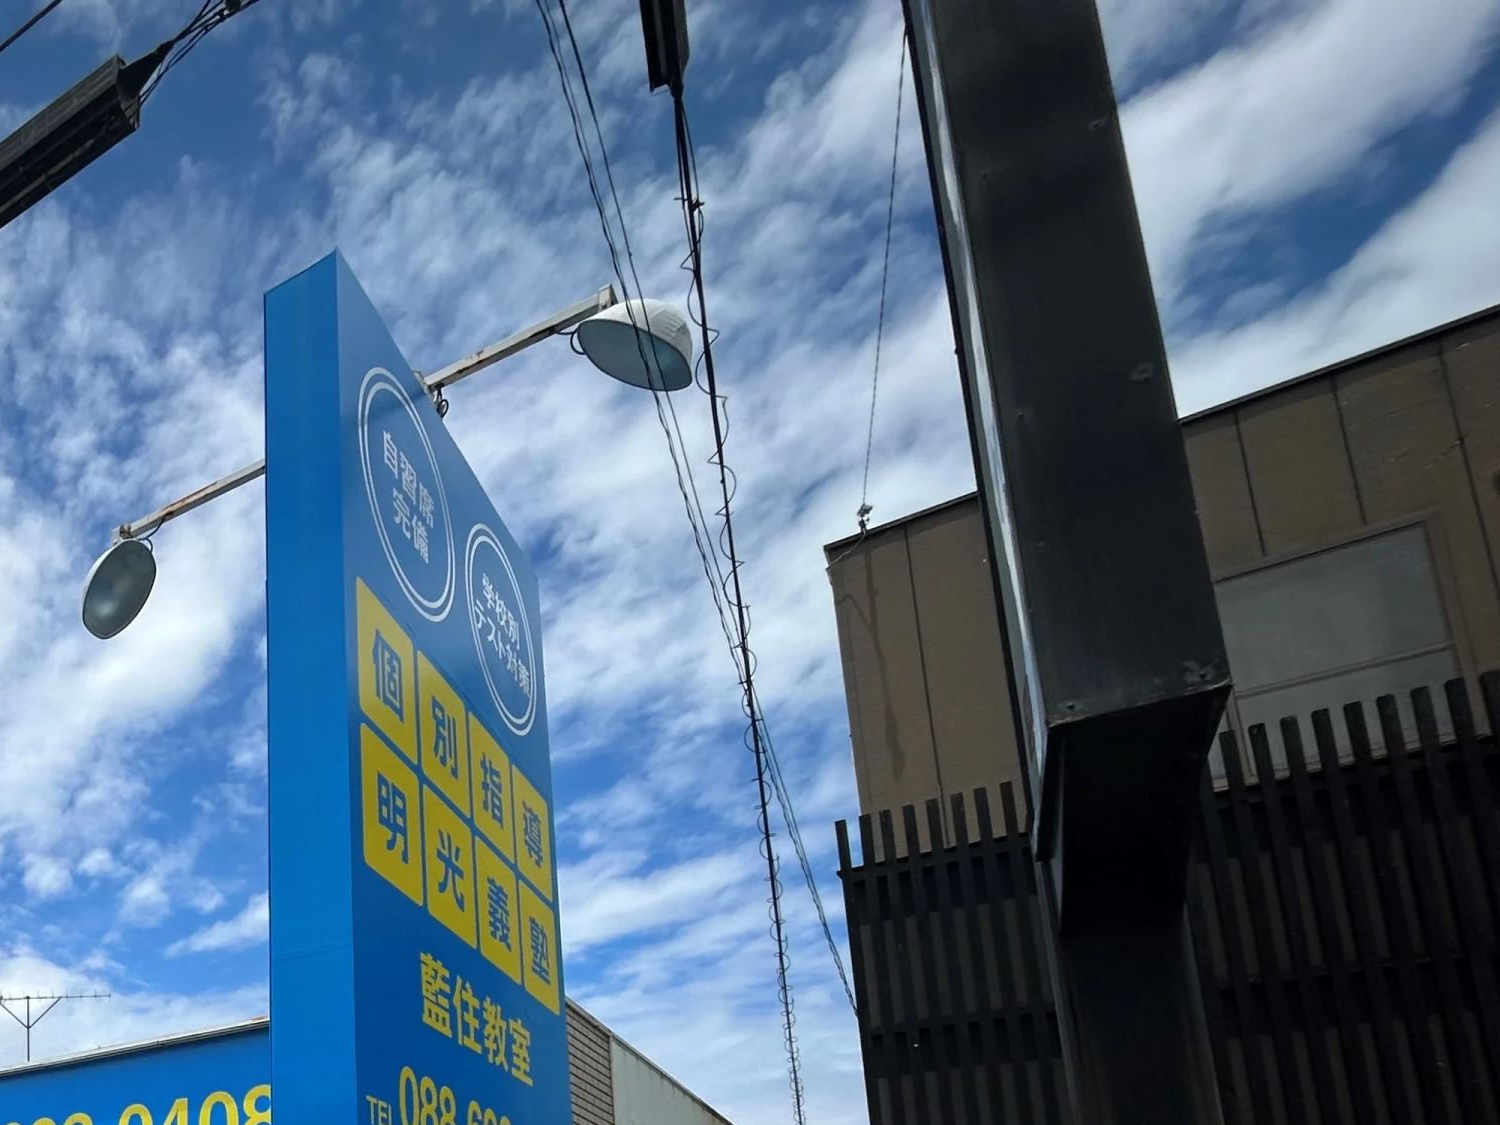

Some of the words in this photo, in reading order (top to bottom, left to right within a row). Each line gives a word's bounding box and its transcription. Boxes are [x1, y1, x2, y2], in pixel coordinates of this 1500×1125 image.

[383, 431, 435, 530] 自習席
[392, 490, 430, 565] 完備
[475, 604, 531, 699] テスト対策
[481, 572, 521, 653] 学校別
[373, 628, 543, 868] 個別指導
[378, 771, 552, 986] 明光義塾
[420, 952, 534, 1088] 藍住教室
